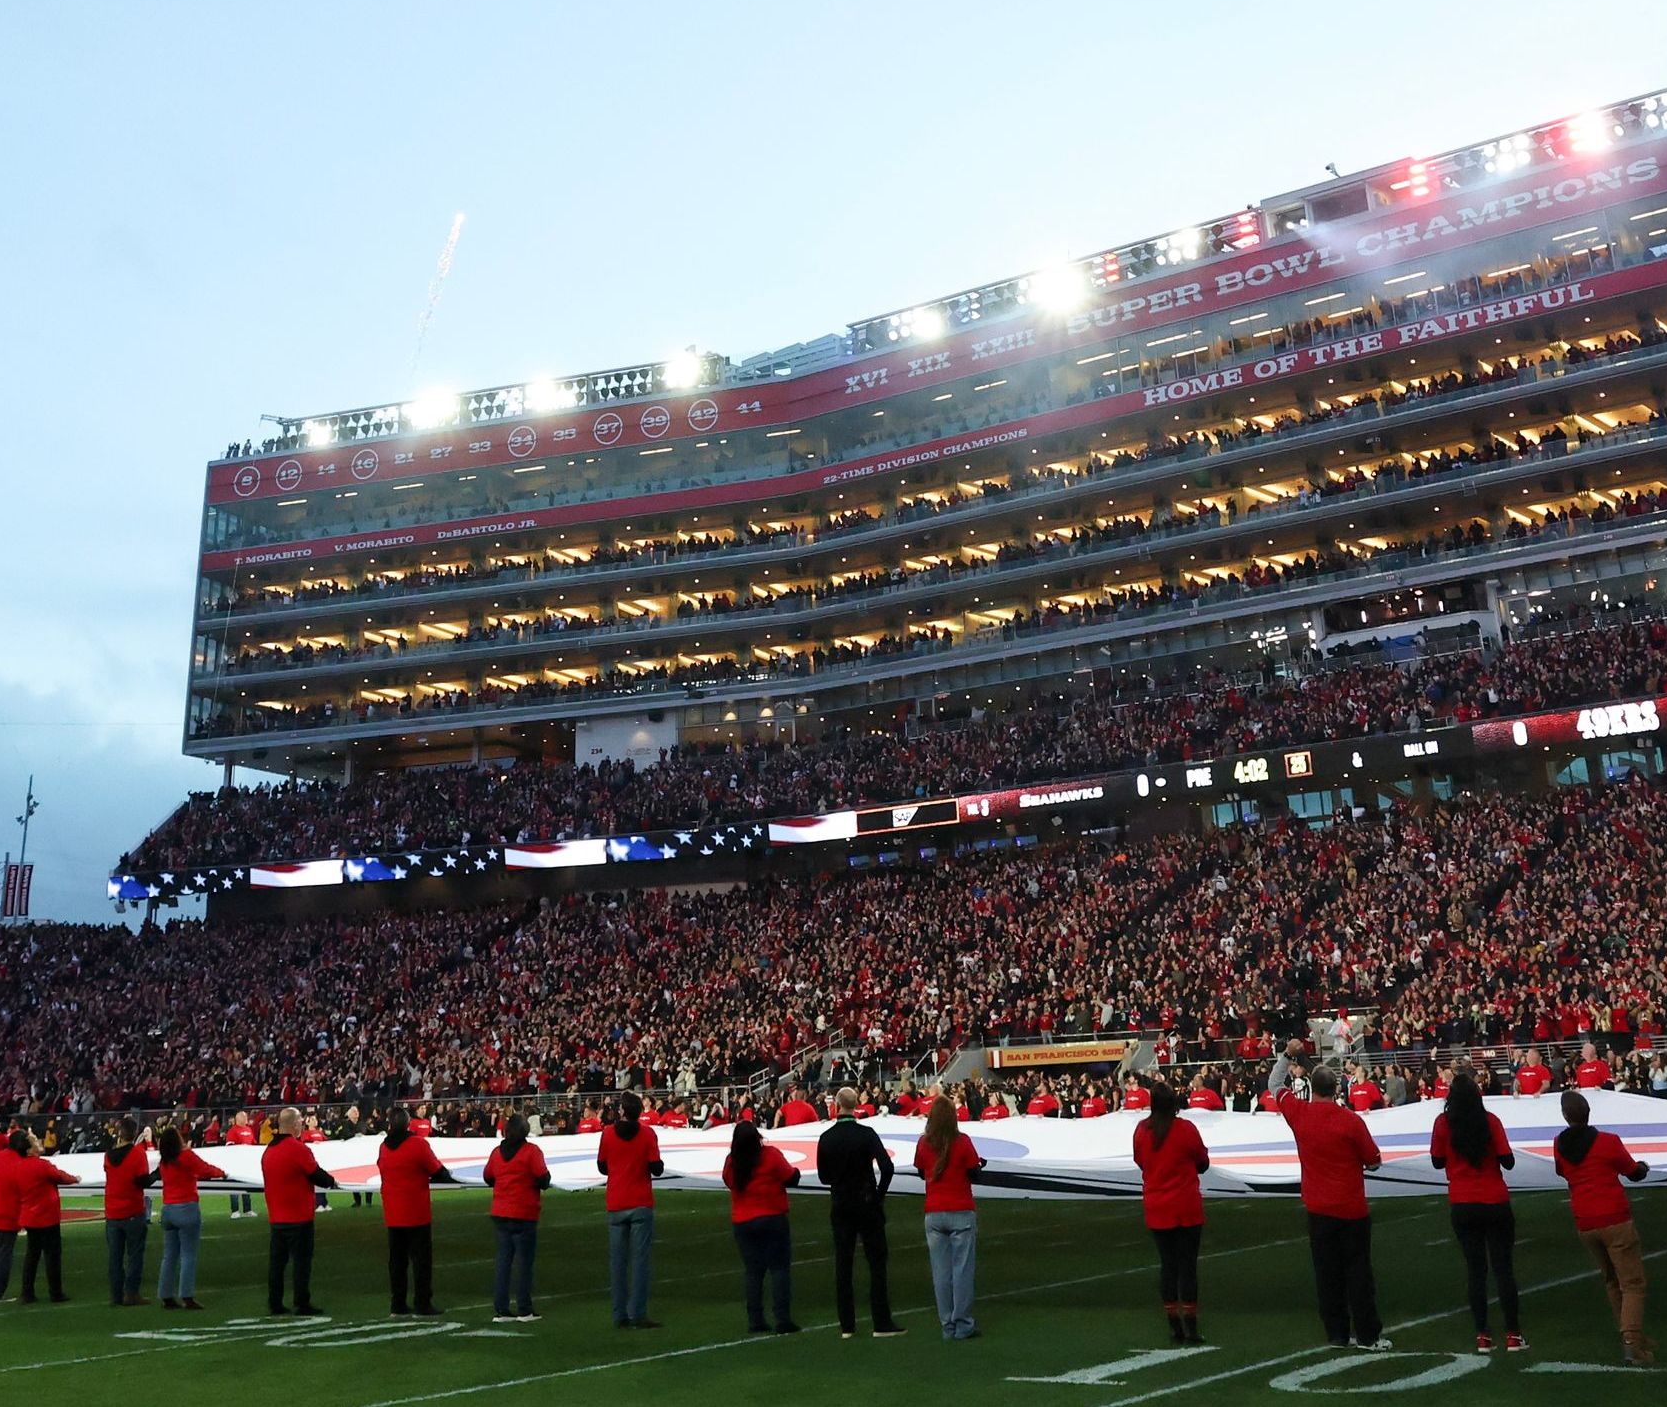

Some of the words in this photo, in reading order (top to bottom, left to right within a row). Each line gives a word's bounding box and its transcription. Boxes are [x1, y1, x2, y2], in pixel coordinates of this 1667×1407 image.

[1067, 282, 1202, 336] SUPER
[1214, 247, 1346, 296] BOWL
[1356, 156, 1661, 258] CHAMPIONS
[1144, 367, 1243, 406] HOME
[1254, 353, 1299, 379] OF
[1307, 332, 1383, 366] THE
[1397, 281, 1595, 344] FAITHFUL
[907, 351, 952, 377] XIX
[845, 368, 888, 394] XVI
[736, 401, 763, 413] 44
[689, 408, 716, 421] 42
[641, 415, 668, 428] 39
[553, 427, 576, 441] 35
[596, 422, 620, 435] 37
[469, 441, 491, 454] 33
[510, 435, 535, 447] 34
[394, 452, 415, 465] 21
[823, 465, 874, 485] 22-TIME
[876, 450, 940, 472] DIVISION
[943, 428, 1028, 456] CHAMPIONS
[317, 464, 337, 475] 14
[355, 457, 375, 470] 16
[279, 468, 298, 481] 12
[347, 535, 414, 552] MORABITO
[246, 548, 312, 564] MORABITO
[1576, 700, 1660, 739] 49ERS
[1186, 767, 1213, 789] PRE
[1233, 757, 1270, 784] 4:02
[894, 811, 912, 822] SAP
[1007, 1052, 1031, 1062] SAN
[1034, 1049, 1099, 1061] FRANCISCO
